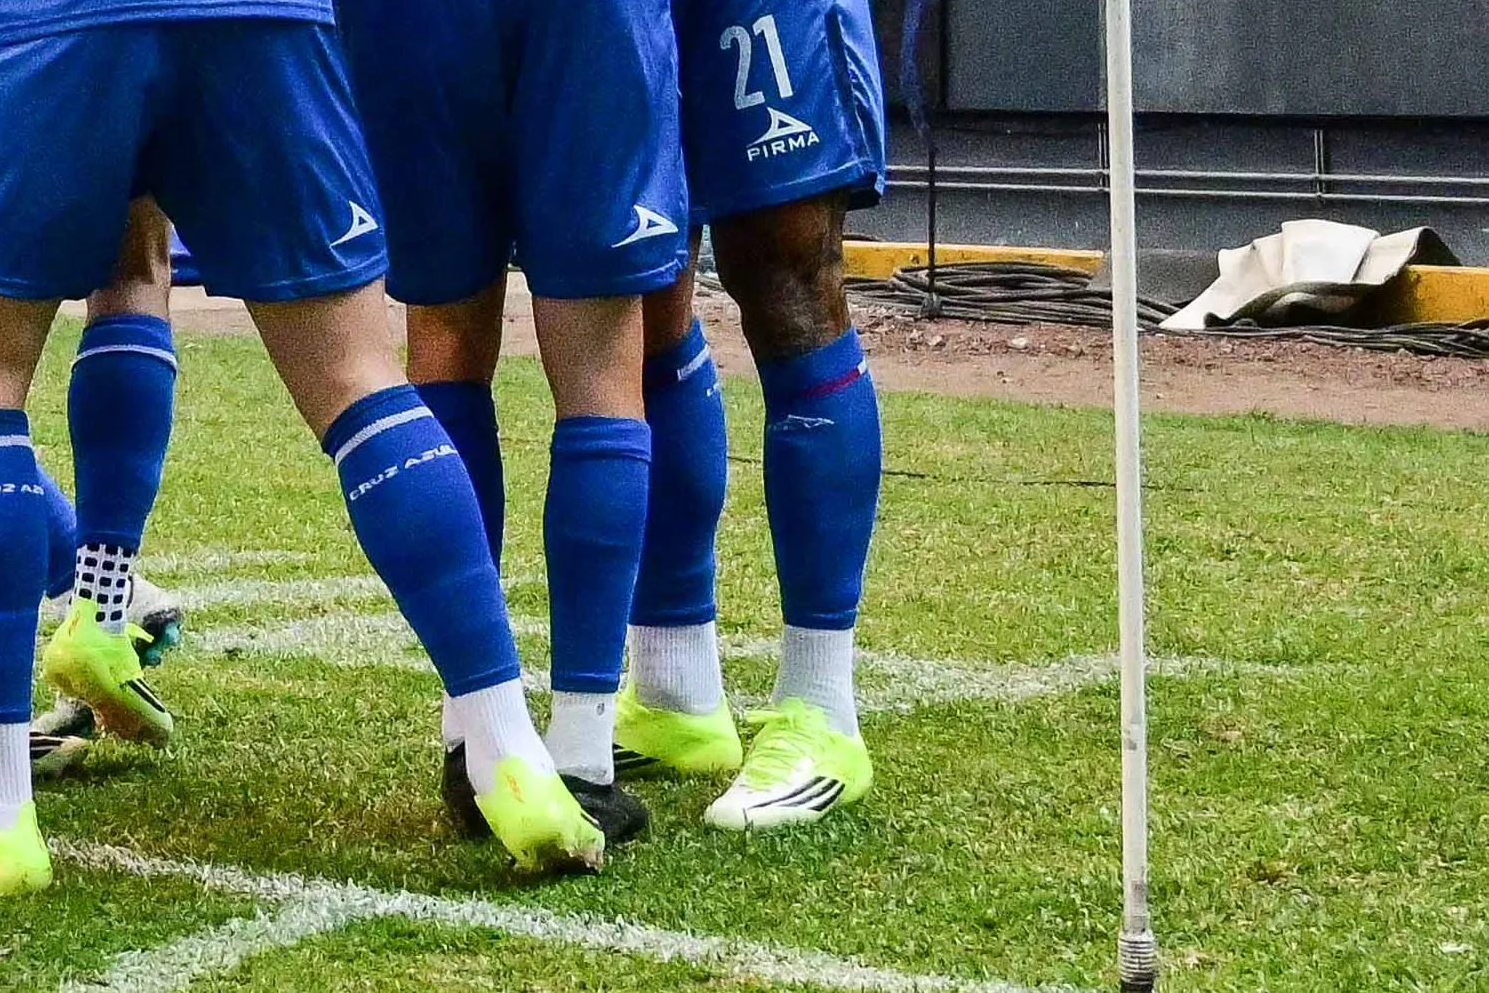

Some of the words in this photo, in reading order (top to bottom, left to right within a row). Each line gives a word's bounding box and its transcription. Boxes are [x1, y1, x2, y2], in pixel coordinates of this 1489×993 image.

[719, 14, 794, 110] 21
[746, 131, 820, 162] PIRMA
[349, 465, 399, 501] CRUZ
